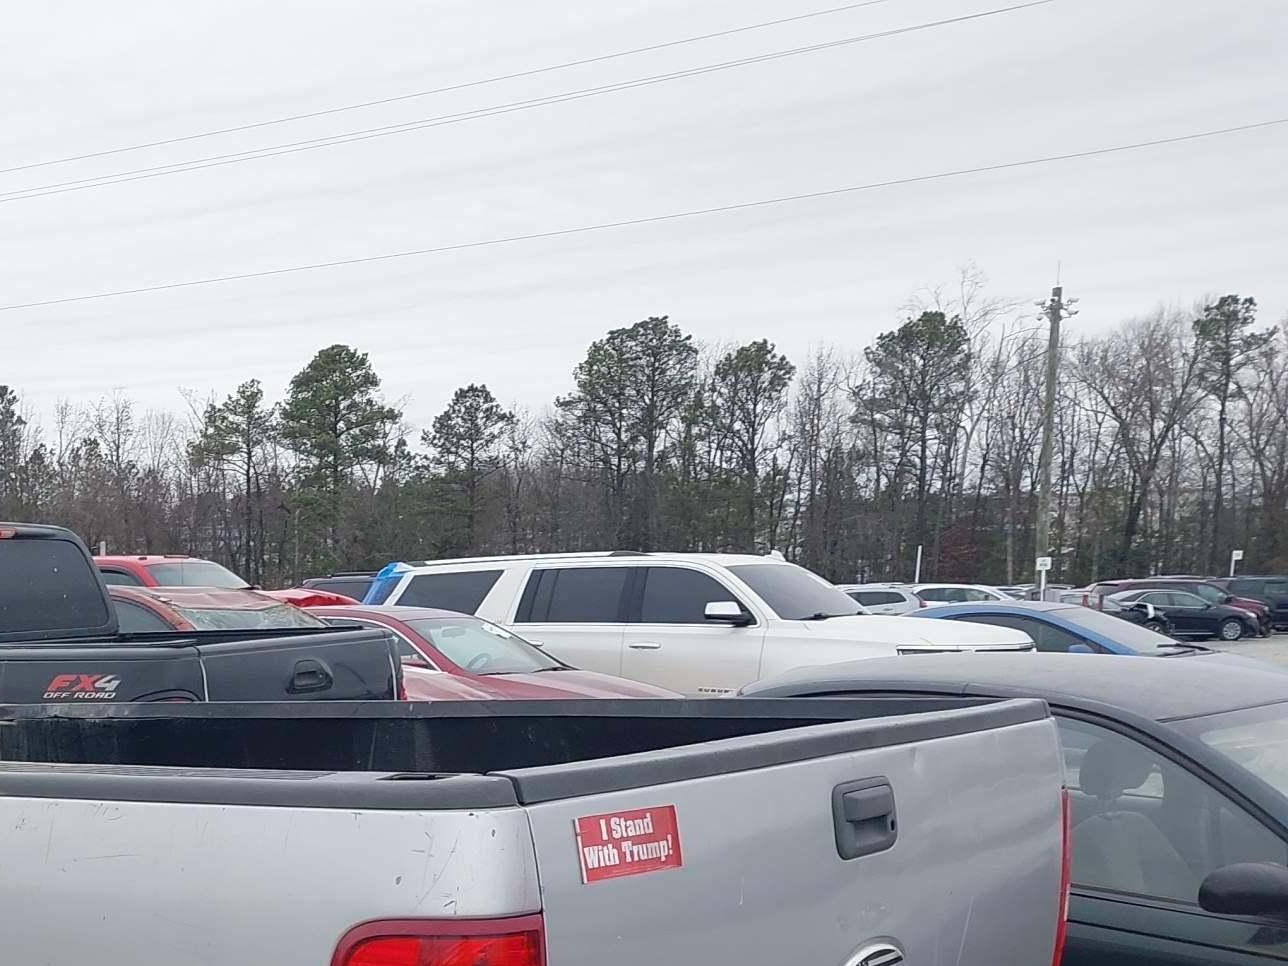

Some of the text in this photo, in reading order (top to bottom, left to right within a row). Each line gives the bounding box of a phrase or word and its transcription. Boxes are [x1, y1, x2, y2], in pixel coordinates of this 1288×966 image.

[47, 674, 121, 691] FX4
[599, 813, 653, 840] I Stand
[584, 834, 673, 869] With Trump!
